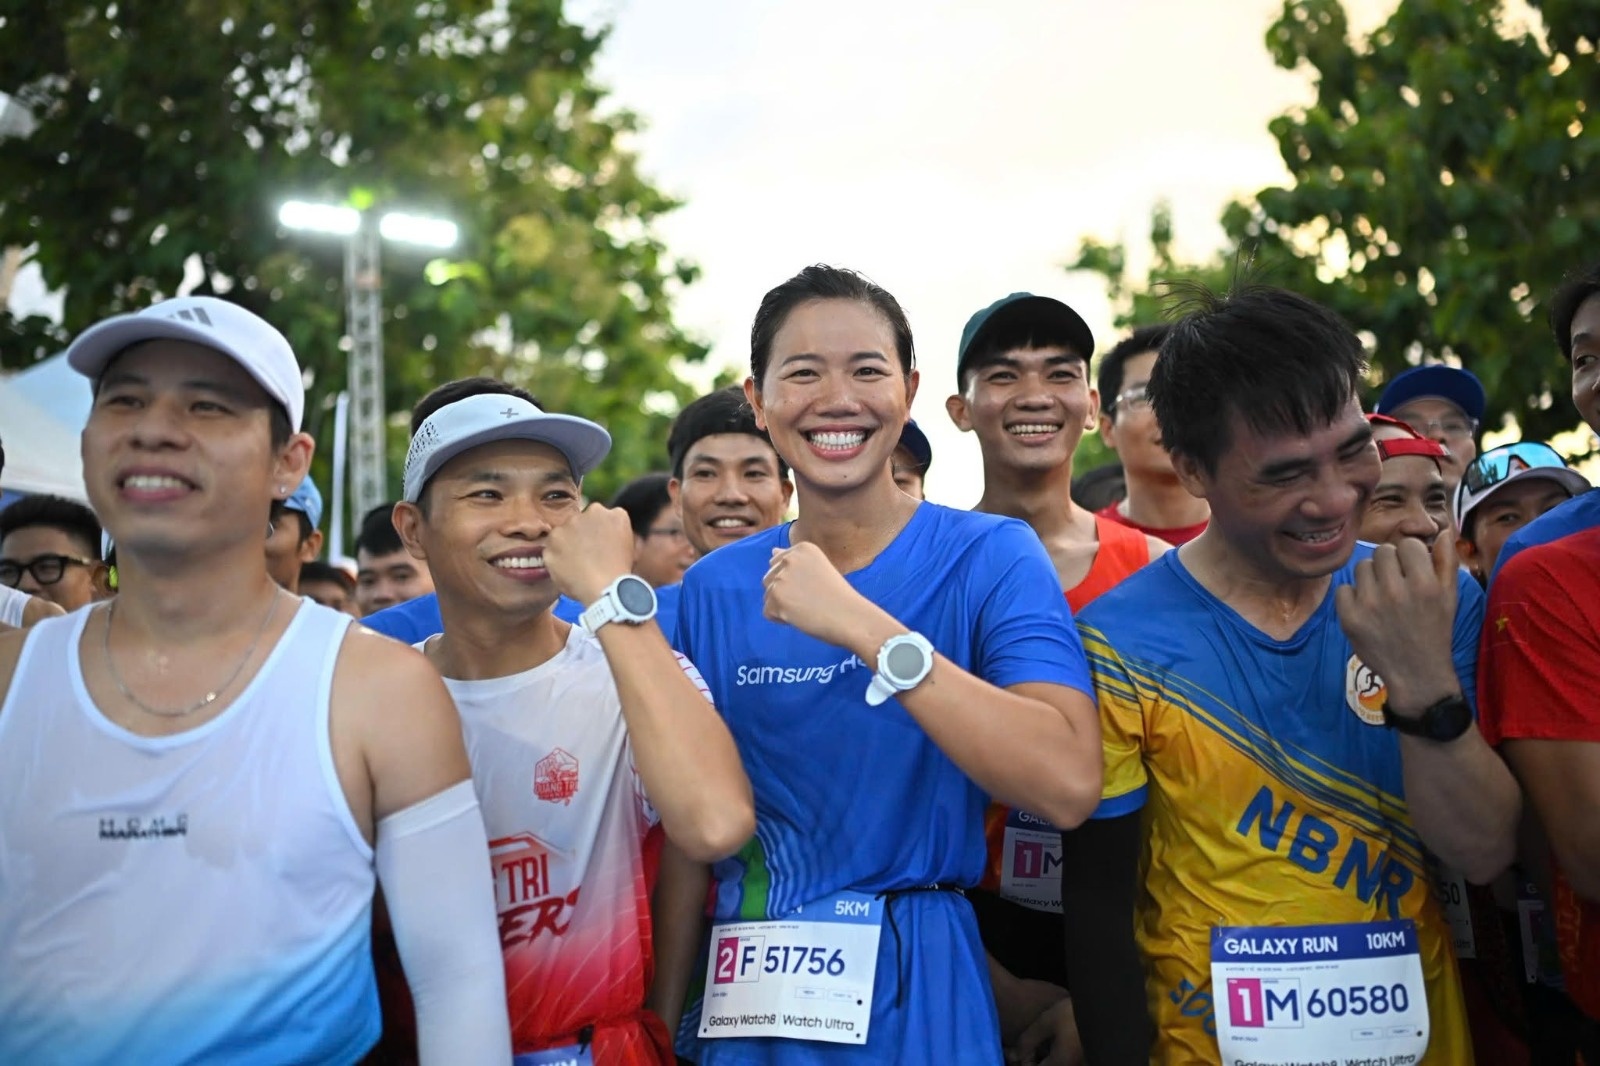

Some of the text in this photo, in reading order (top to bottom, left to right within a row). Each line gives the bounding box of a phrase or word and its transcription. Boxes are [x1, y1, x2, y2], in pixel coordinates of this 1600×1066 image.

[736, 662, 839, 686] Samsung
[1236, 785, 1414, 921] NBNR
[502, 852, 550, 904] TRI
[834, 900, 870, 917] 5KM
[1224, 931, 1406, 955] GALAXY RUN 10KM
[718, 945, 845, 978] 2 F 51756
[1238, 983, 1409, 1022] 1 M 60580
[709, 1014, 855, 1032] Galaxy Watch8 Watch Ultra
[1389, 1054, 1417, 1066] Ultra
